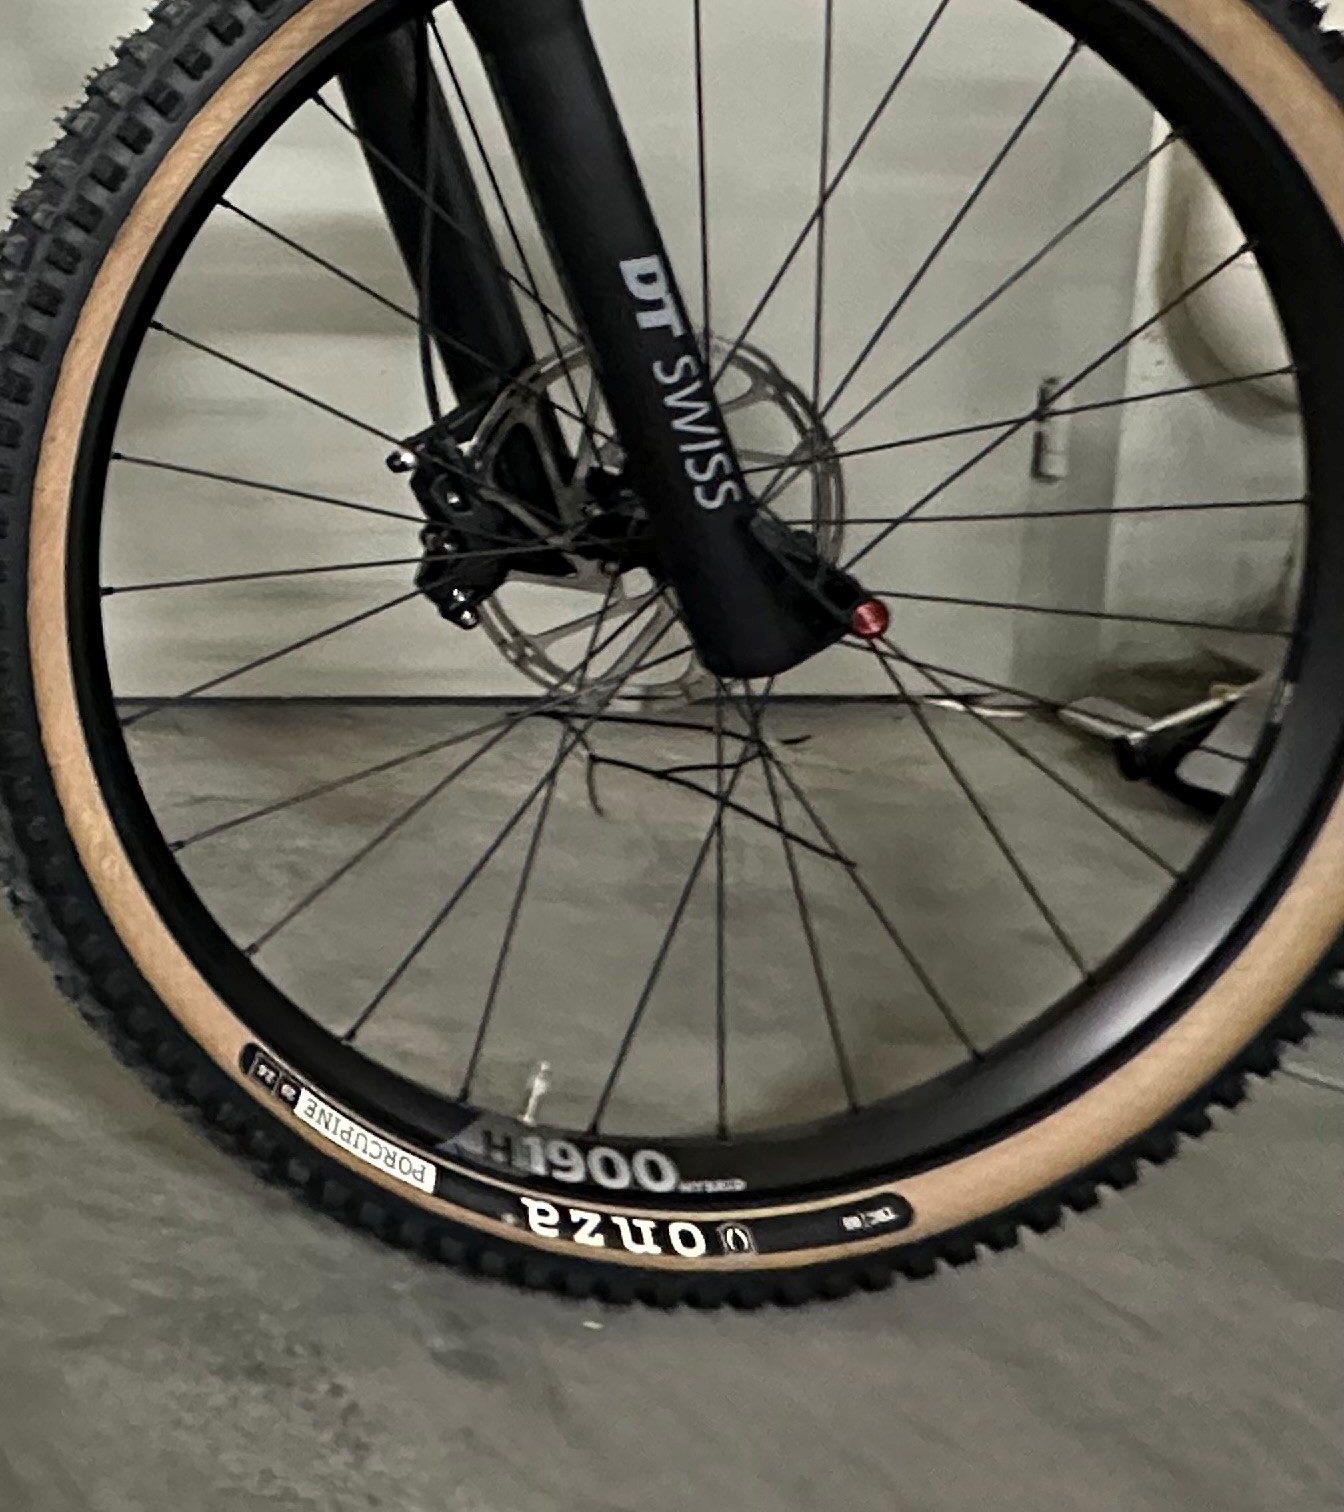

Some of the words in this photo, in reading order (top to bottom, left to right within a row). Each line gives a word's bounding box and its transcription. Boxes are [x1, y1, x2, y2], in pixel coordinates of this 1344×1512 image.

[618, 254, 686, 338] DT
[652, 354, 742, 510] SWISS
[302, 1097, 428, 1184] PORCUPINE
[520, 1196, 708, 1258] onza
